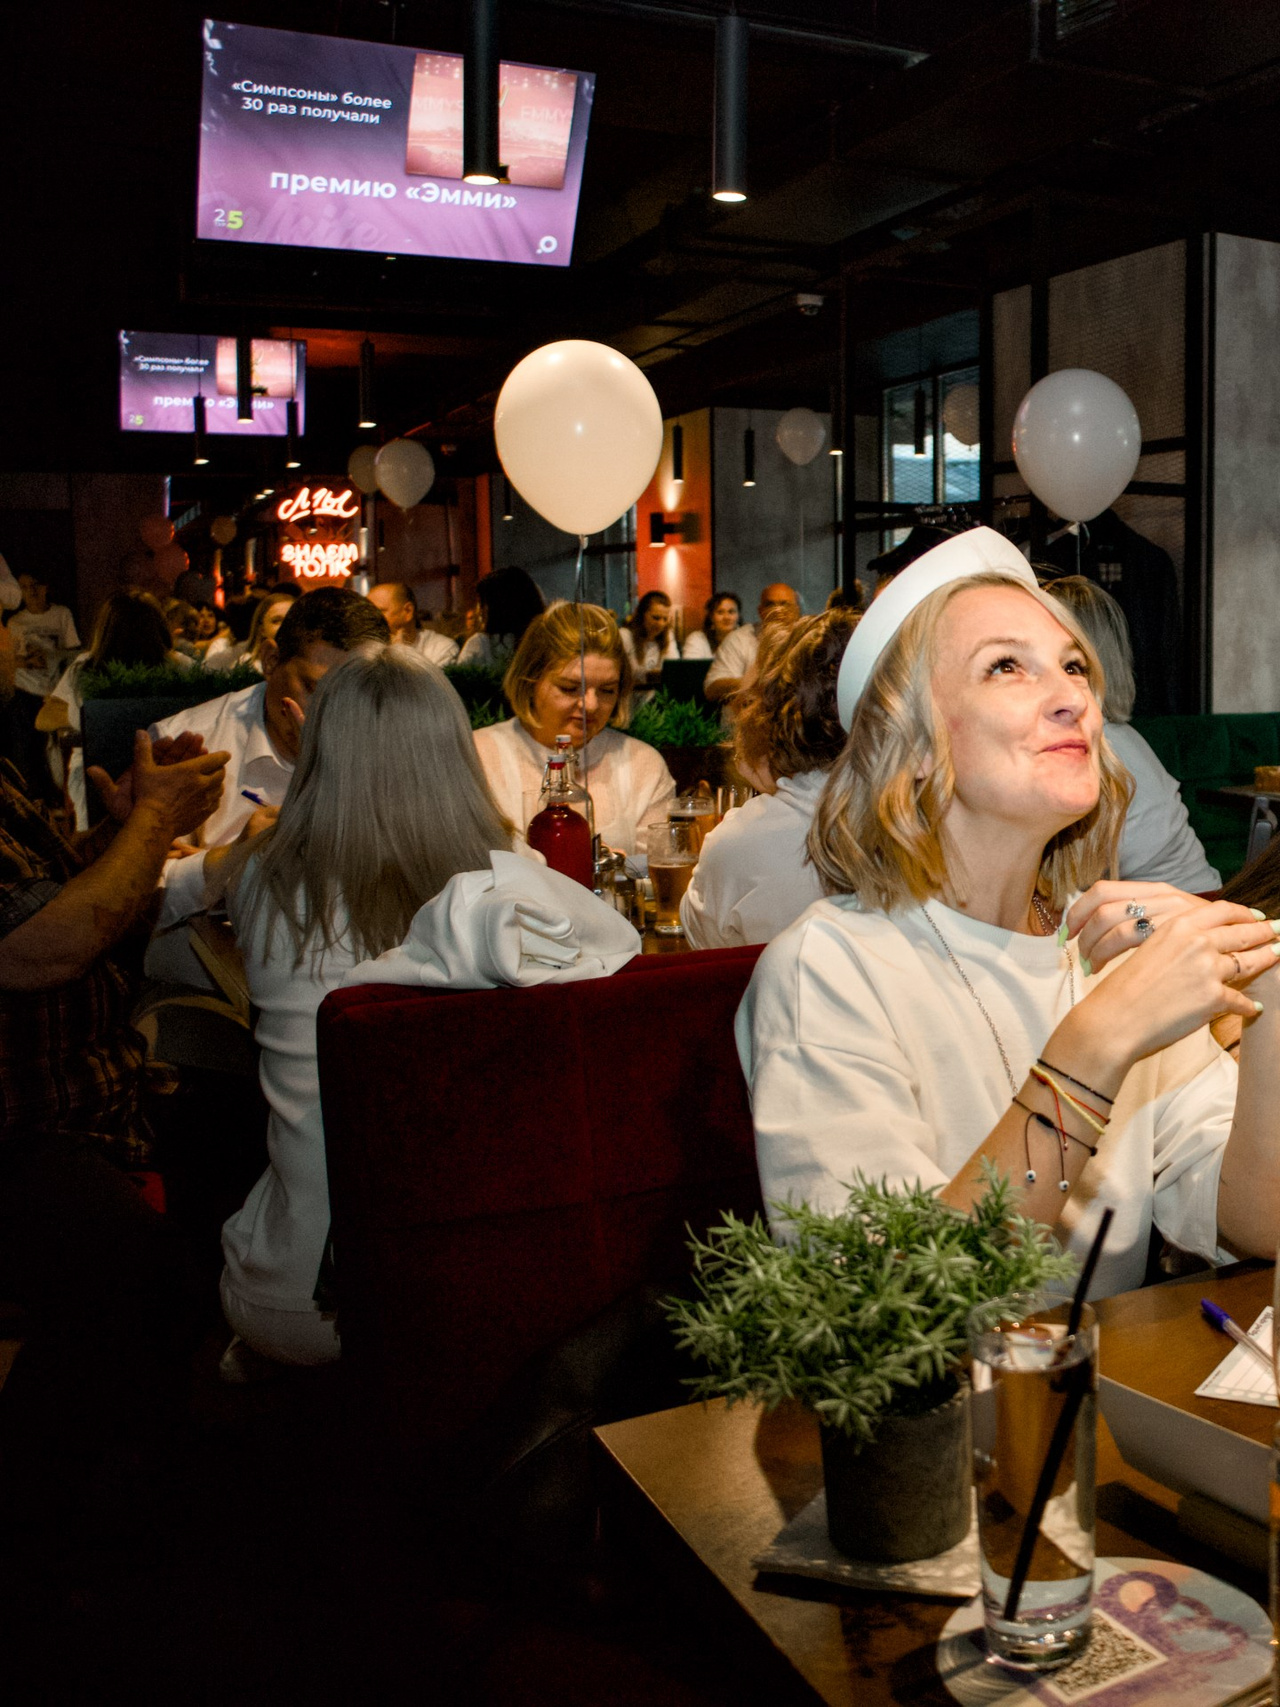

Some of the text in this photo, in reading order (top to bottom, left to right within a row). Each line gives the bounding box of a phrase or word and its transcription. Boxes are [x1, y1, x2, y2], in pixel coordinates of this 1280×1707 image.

[231, 80, 392, 109] «Симпсоны» более
[241, 97, 380, 124] 30 раз получали
[270, 172, 518, 209] премию «Эмми»
[289, 558, 353, 578] ТОЛК
